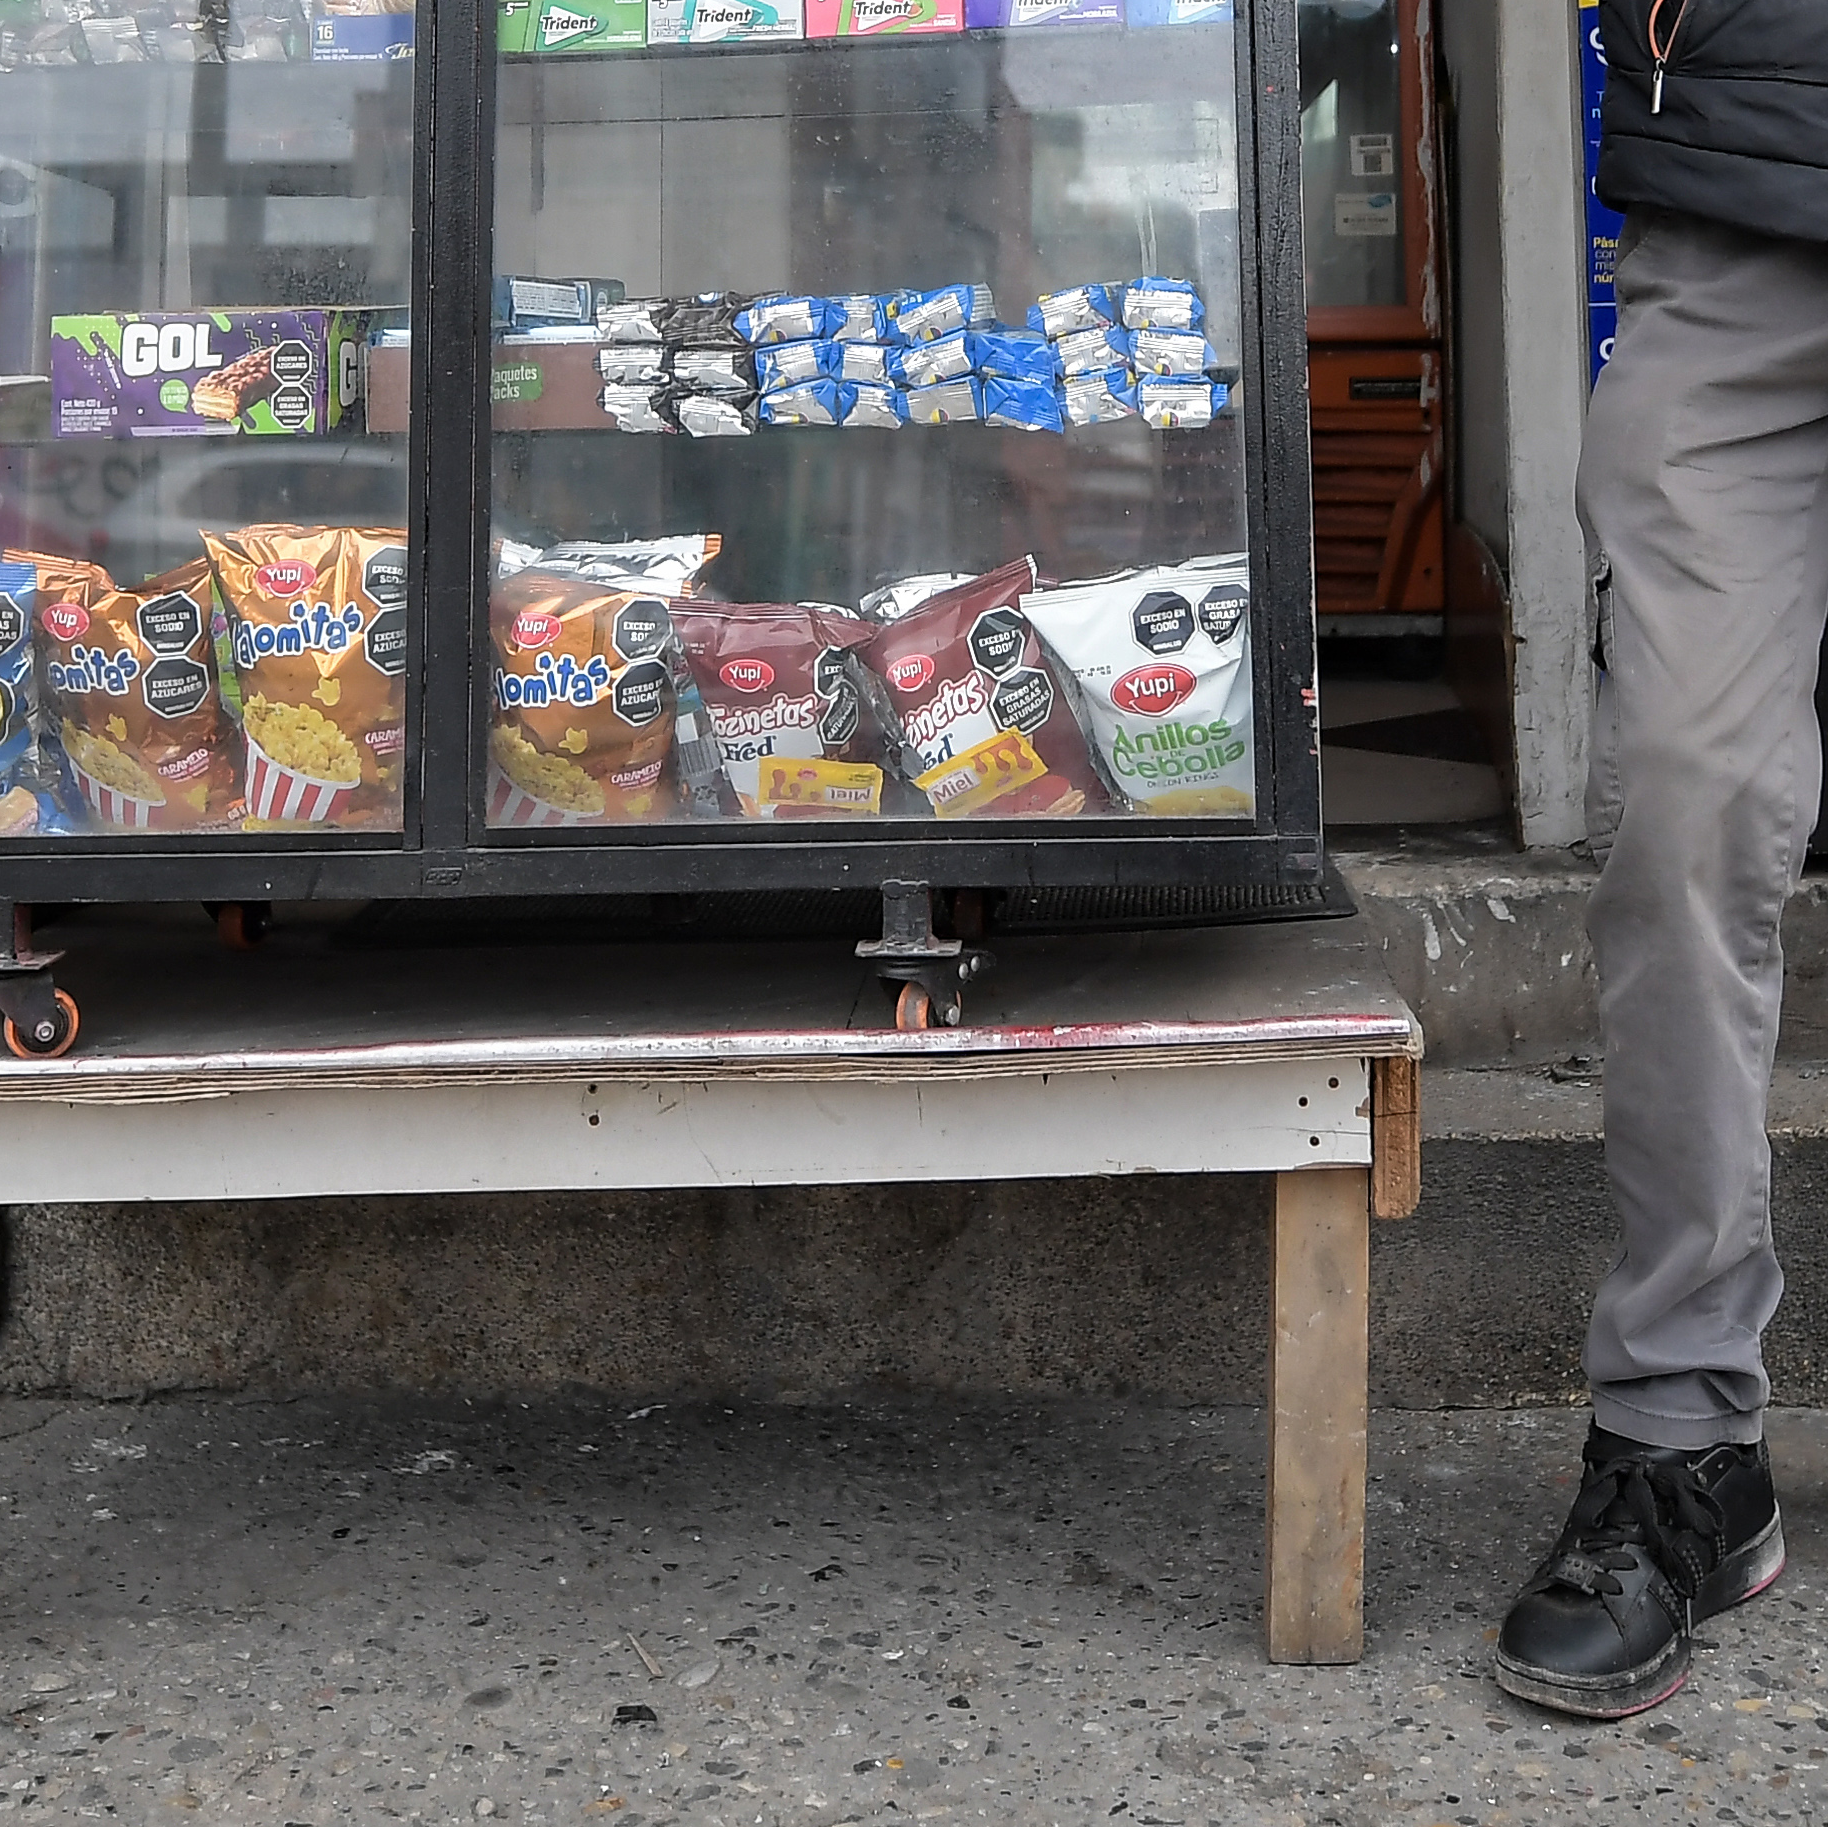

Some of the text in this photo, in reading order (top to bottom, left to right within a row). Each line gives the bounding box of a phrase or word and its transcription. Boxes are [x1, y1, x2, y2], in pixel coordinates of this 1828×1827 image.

[696, 8, 752, 23] Trident
[855, 0, 910, 16] Trident
[541, 15, 597, 31] Trident
[317, 25, 333, 40] 16
[122, 322, 222, 377] GOL
[494, 367, 538, 383] aquetes
[494, 384, 520, 400] acks
[268, 567, 301, 583] Yupi
[1205, 599, 1238, 611] EXCESO
[2, 612, 14, 620] EN
[146, 611, 191, 625] EXCESO EN
[1140, 608, 1186, 624] EXCESO EN
[154, 622, 184, 634] SODIO
[517, 618, 549, 634] Yupi
[623, 621, 655, 632] EXCESO
[1150, 620, 1180, 632] SODIO
[979, 634, 1010, 647] EXCESO
[729, 667, 761, 683] Yupi
[894, 659, 923, 681] Yupi
[152, 674, 198, 689] EXCESO EN
[623, 683, 655, 696] EXCESO
[1124, 672, 1177, 698] Yupi
[999, 677, 1040, 707] EXCESO EN
[1003, 690, 1051, 727] SATURADAS
[1006, 686, 1042, 715] GRASAS
[1116, 718, 1233, 756] Anillos
[724, 735, 774, 762] Fred
[1113, 737, 1245, 779] Cebolla
[830, 786, 871, 800] Miel
[933, 771, 973, 803] Miel
